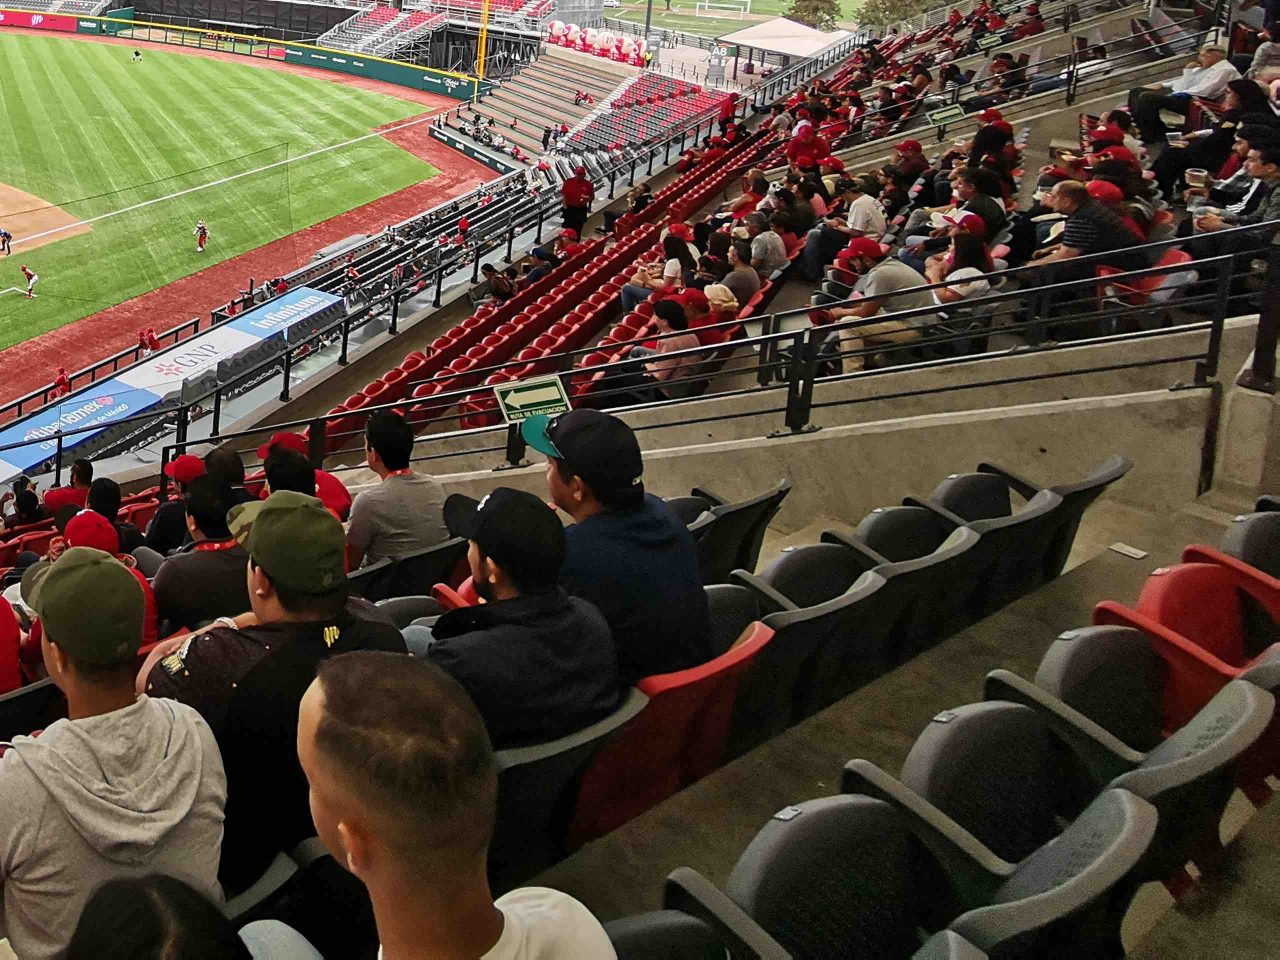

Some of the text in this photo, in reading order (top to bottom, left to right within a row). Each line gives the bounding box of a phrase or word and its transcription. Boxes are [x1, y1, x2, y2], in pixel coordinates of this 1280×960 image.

[712, 47, 728, 56] A8
[249, 295, 322, 330] infinitum
[173, 343, 220, 368] GNP
[510, 412, 524, 420] RUTA
